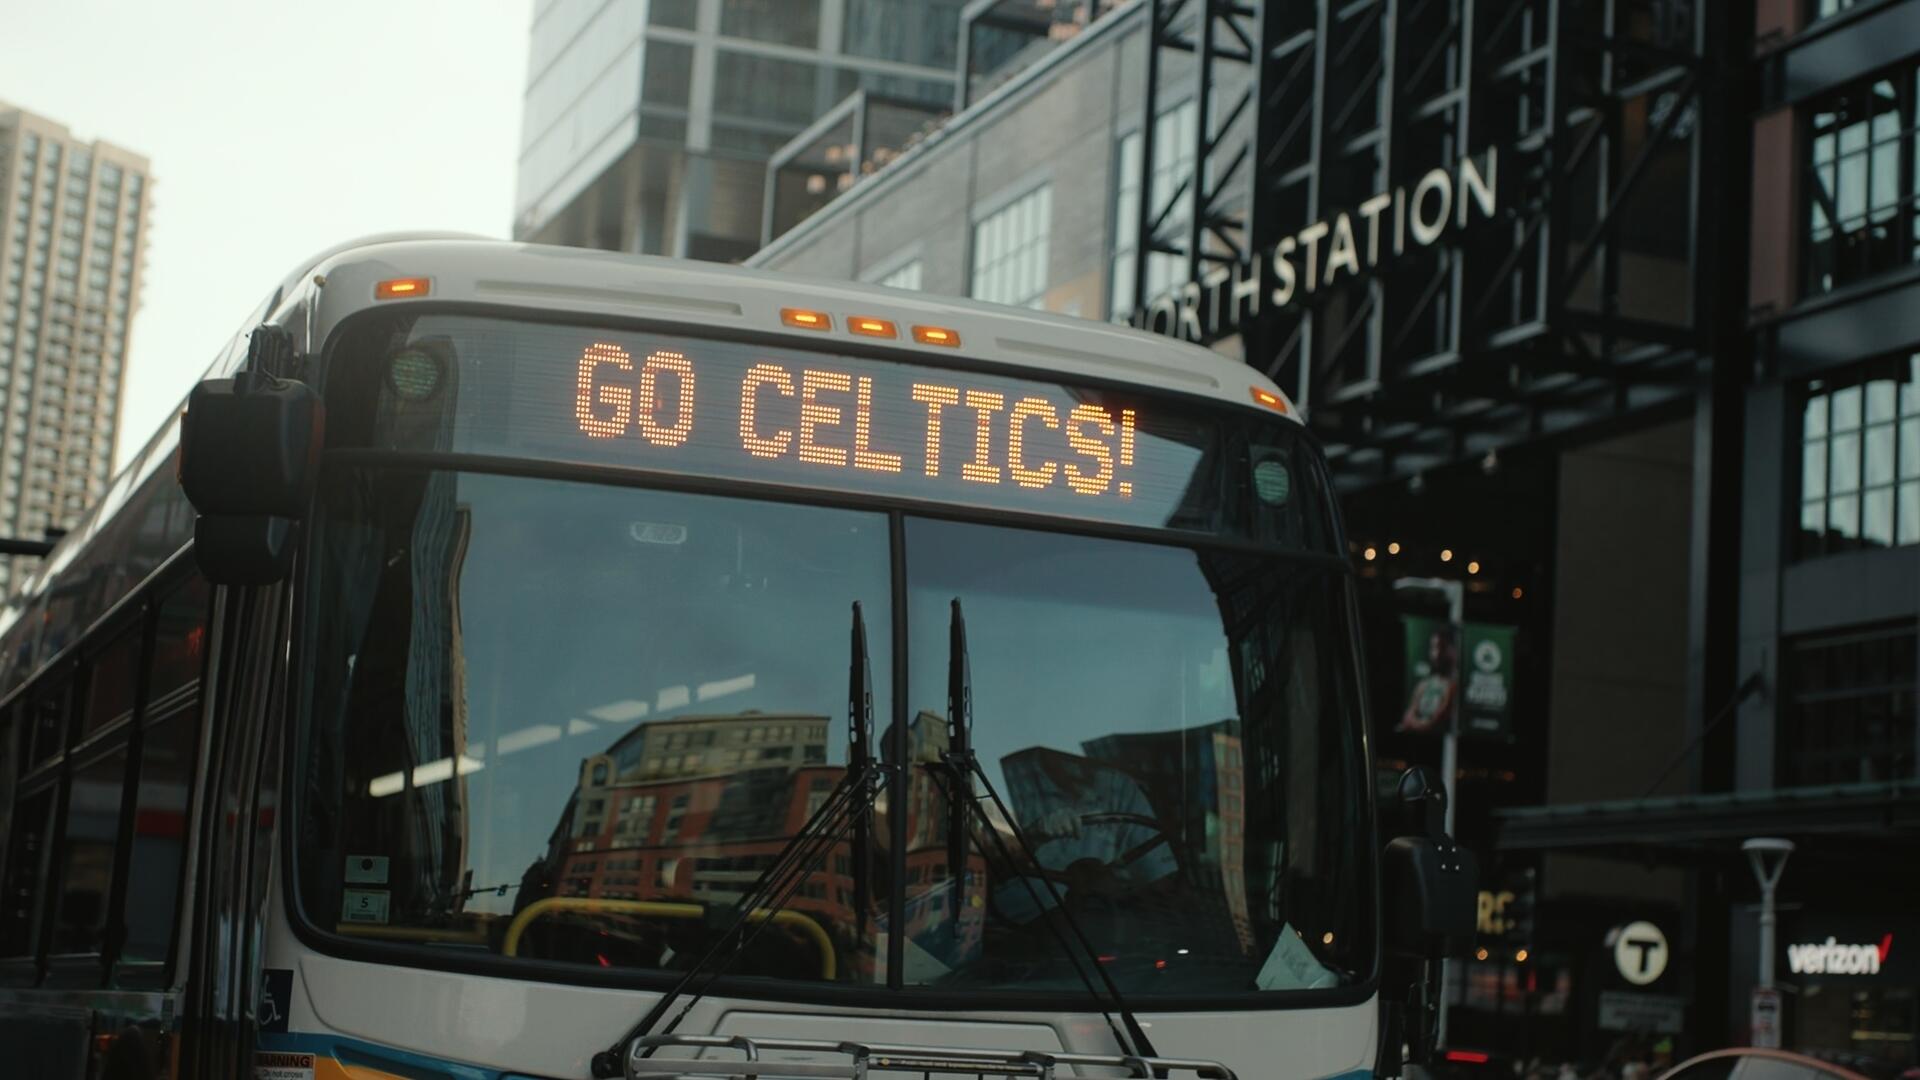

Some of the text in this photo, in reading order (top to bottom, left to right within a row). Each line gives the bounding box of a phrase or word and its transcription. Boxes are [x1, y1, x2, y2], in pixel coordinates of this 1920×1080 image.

[1135, 145, 1496, 342] ORTH STATION
[576, 343, 1136, 497] GO CELTICS!
[1626, 939, 1659, 974] T
[1787, 935, 1880, 975] verizon
